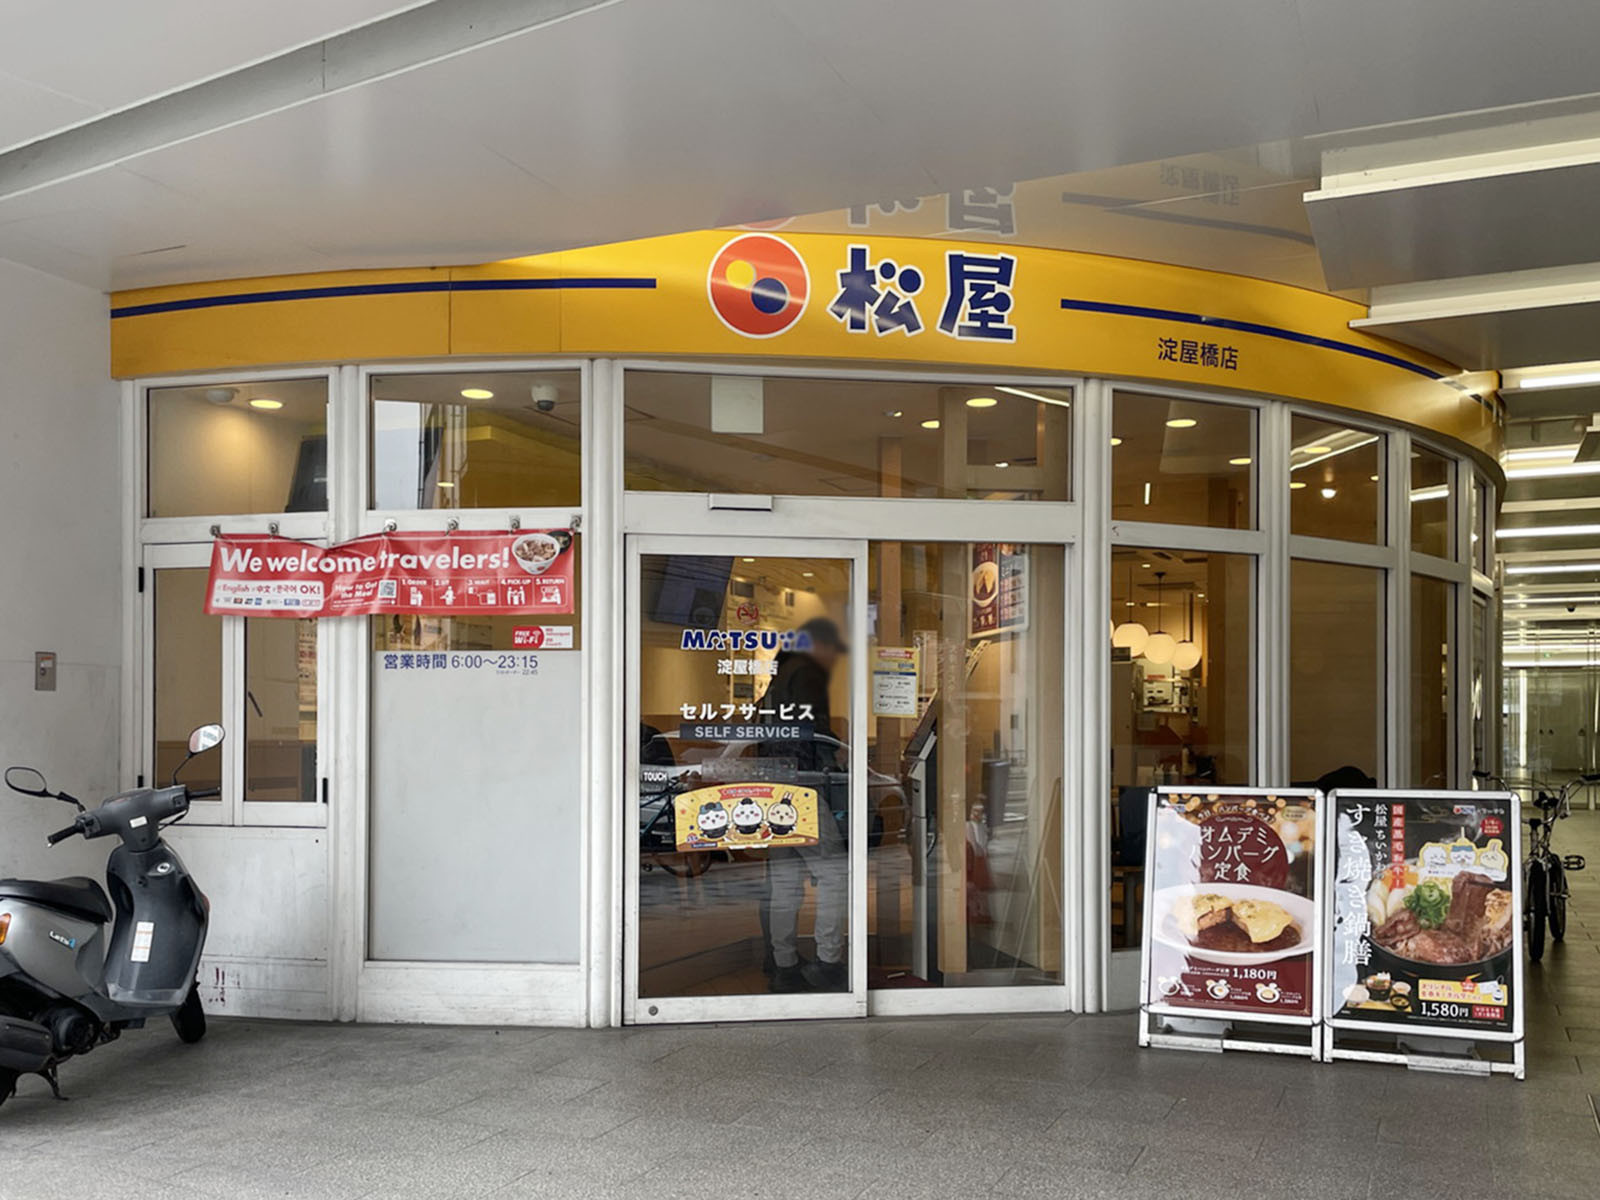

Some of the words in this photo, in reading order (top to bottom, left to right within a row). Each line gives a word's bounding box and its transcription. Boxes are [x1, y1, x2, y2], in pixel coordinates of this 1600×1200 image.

[826, 244, 1017, 342] 松屋
[1157, 337, 1239, 371] 淀屋橋店
[220, 547, 263, 573] We
[266, 549, 376, 573] welcome
[379, 546, 510, 569] travelers!
[299, 584, 321, 595] OK!
[383, 654, 447, 670] 営業時間
[679, 703, 815, 721] セルフサービス
[694, 726, 732, 739] SELF
[735, 726, 800, 739] SERVICE
[1200, 826, 1268, 846] オムデミ
[1190, 845, 1279, 863] ハンバーグ
[1214, 862, 1251, 882] 定食
[1233, 968, 1277, 980] 1,180円
[1421, 1002, 1468, 1017] 1,580円
